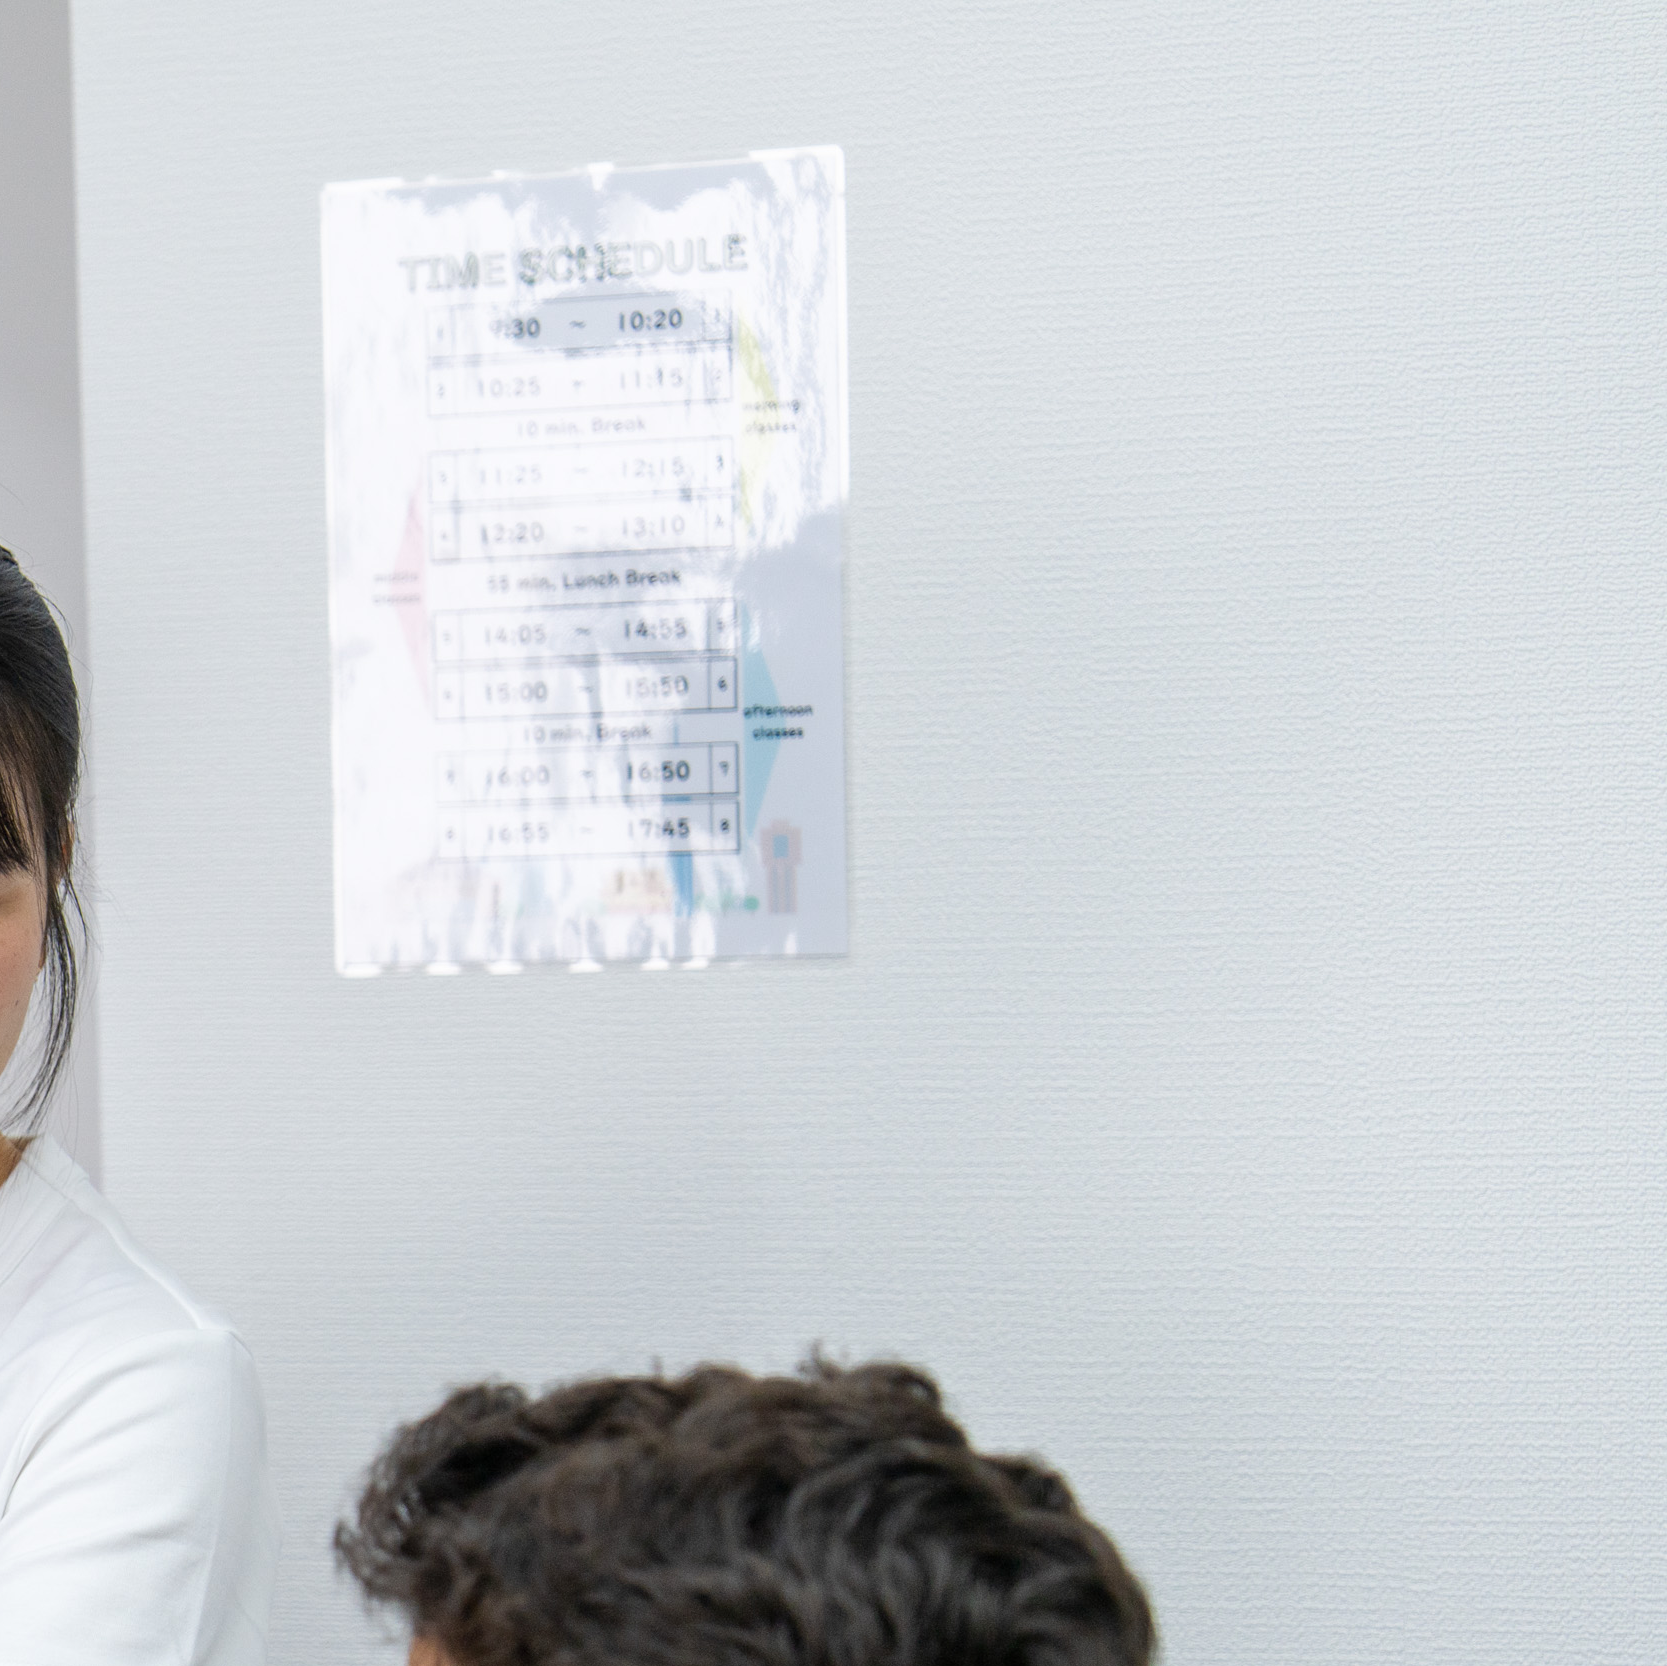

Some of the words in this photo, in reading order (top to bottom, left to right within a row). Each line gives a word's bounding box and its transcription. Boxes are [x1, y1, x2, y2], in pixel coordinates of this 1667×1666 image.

[397, 251, 506, 294] TIME
[517, 233, 749, 286] SCHEDULE
[618, 307, 683, 332] 10:20
[476, 375, 541, 398] 10:25
[619, 368, 683, 390] 11:15
[517, 421, 538, 438] 10
[591, 416, 647, 433] Break
[479, 464, 543, 485] 11:25
[621, 455, 685, 479] 12:15
[480, 521, 545, 545] 12:20
[622, 514, 685, 537] 13:10
[562, 571, 619, 591] Lunch
[625, 568, 681, 586] Break
[485, 624, 547, 646] 14:05
[625, 618, 687, 640] 14:55
[485, 680, 548, 704] 15:00
[625, 674, 689, 698] 15:50
[743, 703, 814, 719] afternoon
[523, 724, 546, 743] 10
[595, 721, 651, 742] Break
[753, 726, 804, 740] classes
[486, 764, 551, 787] 16:00
[626, 759, 691, 781] 16:50
[487, 822, 549, 844] 16:55
[627, 818, 689, 839] 17:45
